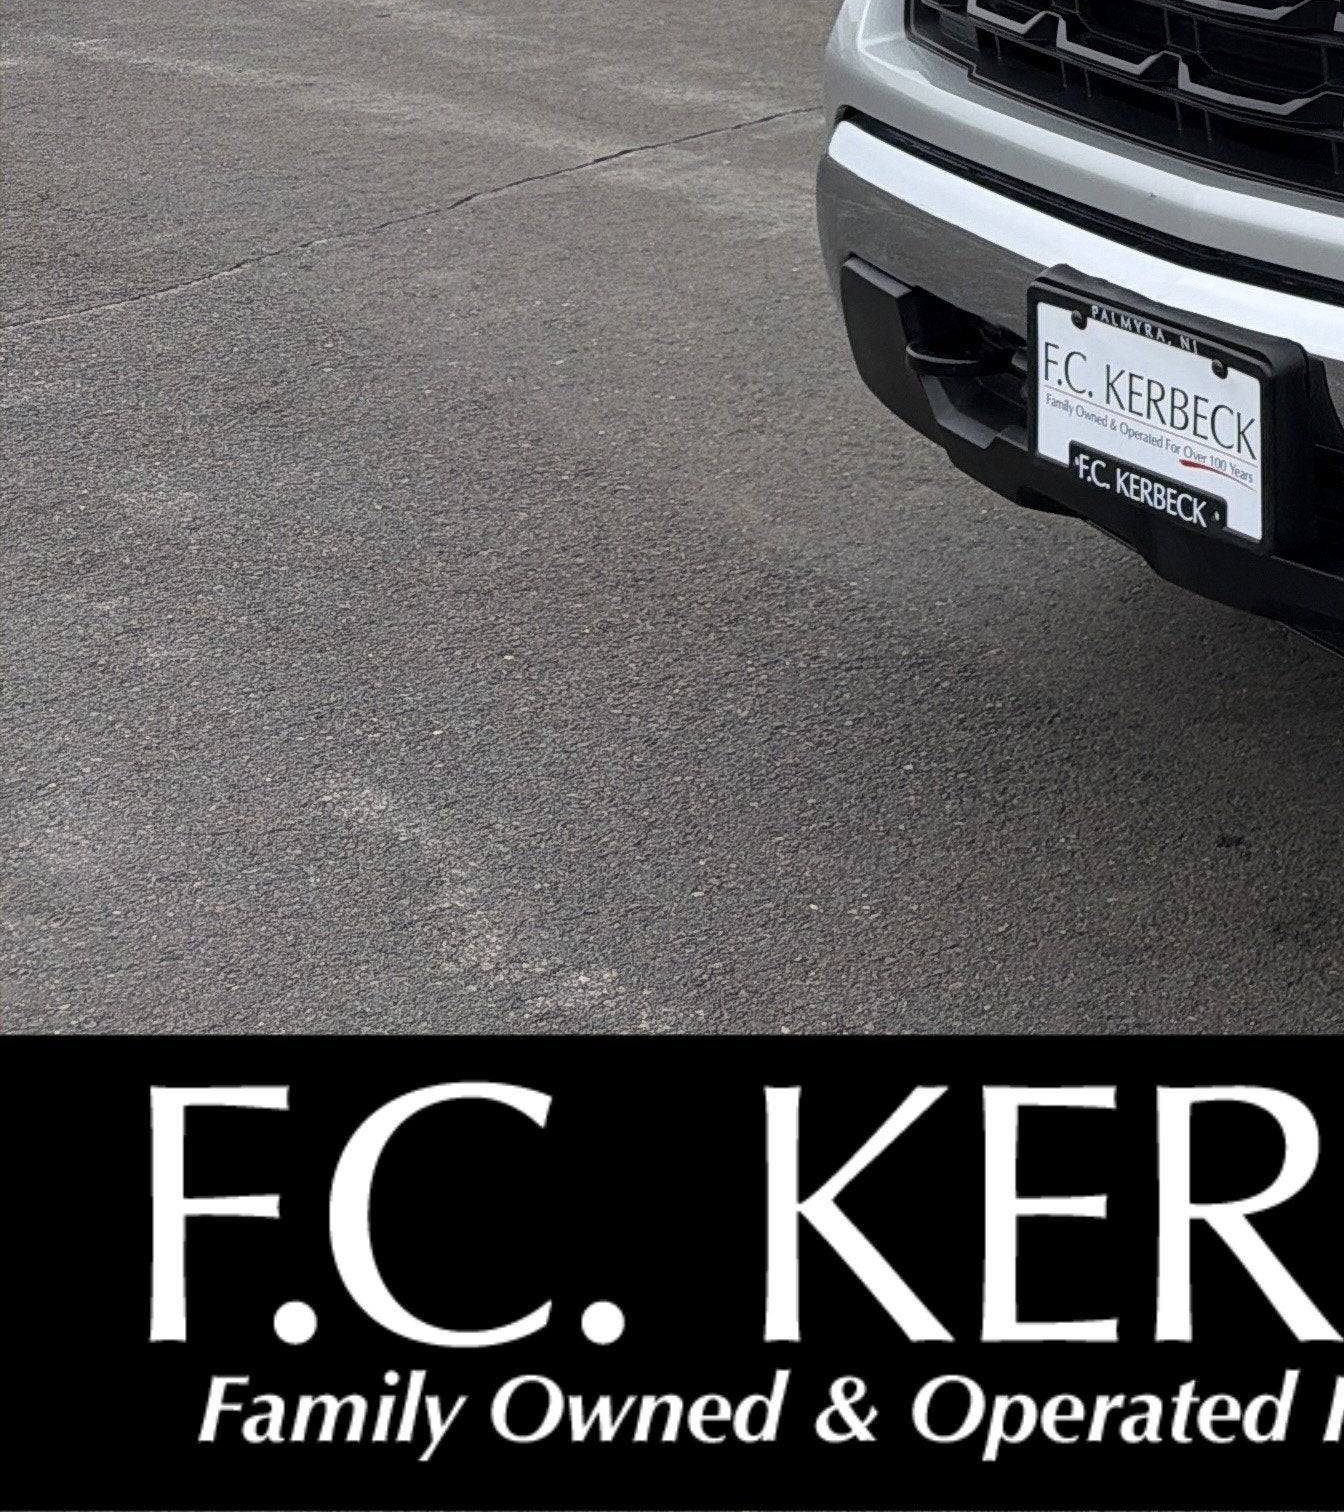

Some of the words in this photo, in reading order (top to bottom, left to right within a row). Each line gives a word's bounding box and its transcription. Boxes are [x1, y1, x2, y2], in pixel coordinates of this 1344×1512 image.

[1091, 305, 1174, 345] PALMYRA,
[1044, 341, 1094, 399] F.C.
[1105, 364, 1258, 461] KERBECK
[1046, 393, 1074, 417] Family
[1075, 406, 1108, 428] Owned
[1110, 417, 1117, 431] &
[1120, 421, 1163, 448] Operated
[1165, 434, 1181, 455] For
[1183, 445, 1207, 464] Over
[1210, 455, 1227, 472] 100
[1229, 463, 1254, 484] Years
[1078, 453, 1111, 490] F.C.
[1116, 468, 1208, 528] KERBECK
